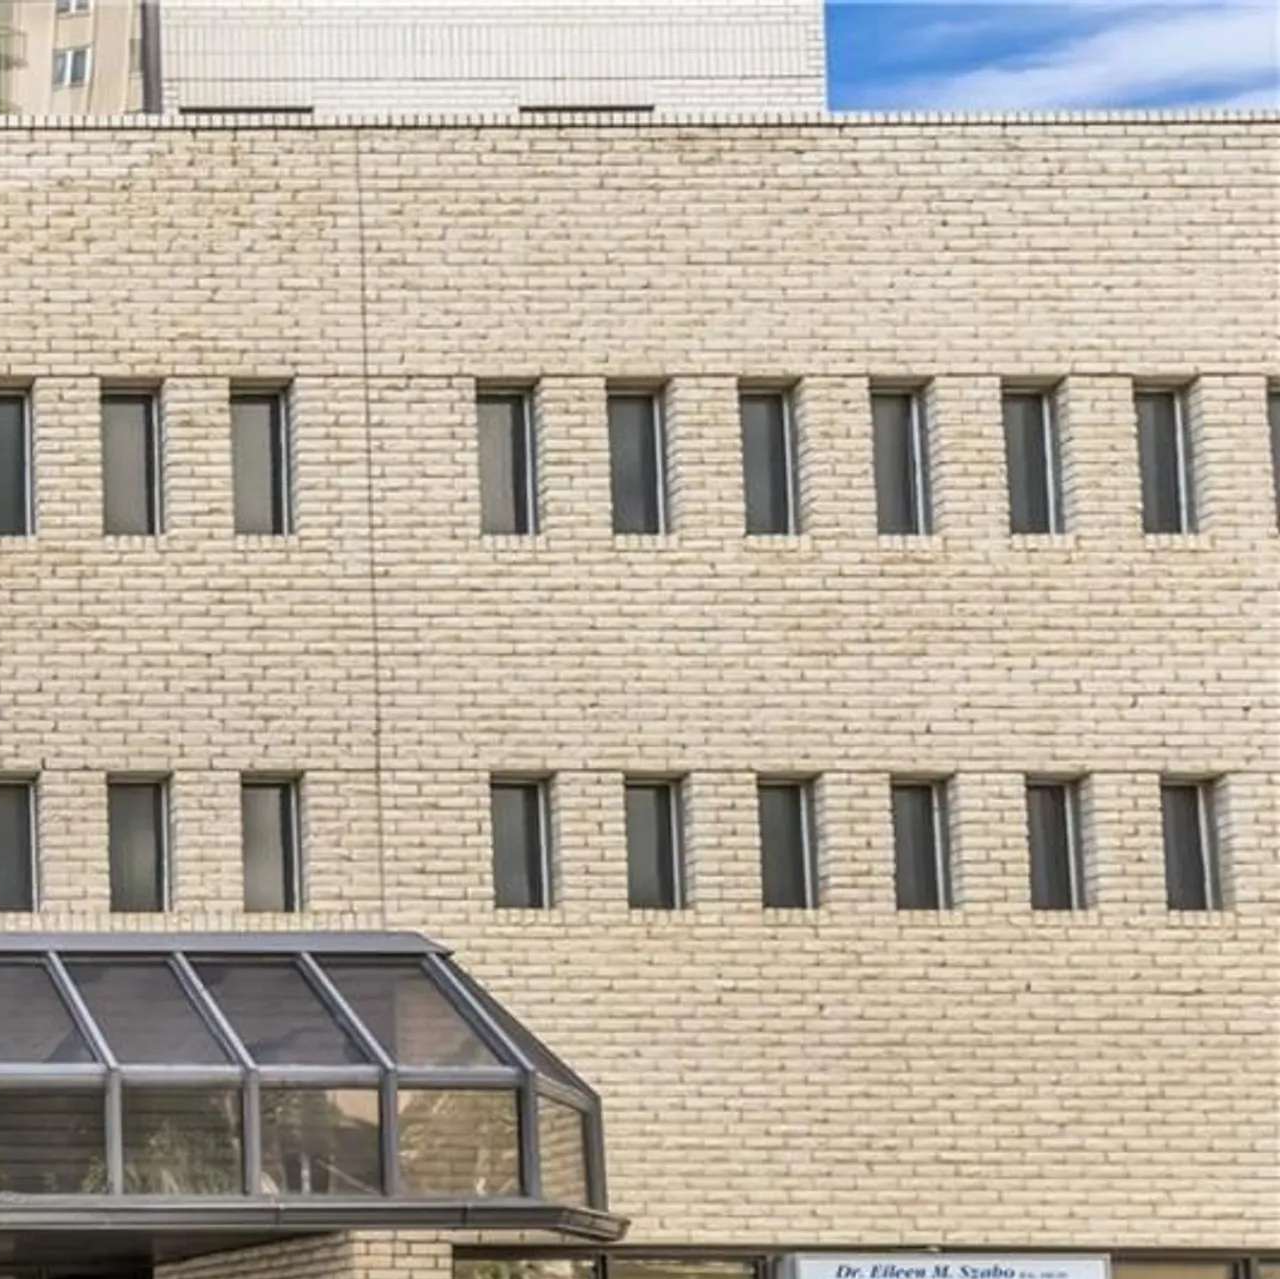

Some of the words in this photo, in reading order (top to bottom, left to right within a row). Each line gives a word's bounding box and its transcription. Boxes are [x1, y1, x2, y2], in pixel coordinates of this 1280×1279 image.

[836, 1264, 862, 1279] Dr.
[870, 1264, 926, 1279] Eileen
[959, 1263, 1016, 1279] Szabo
